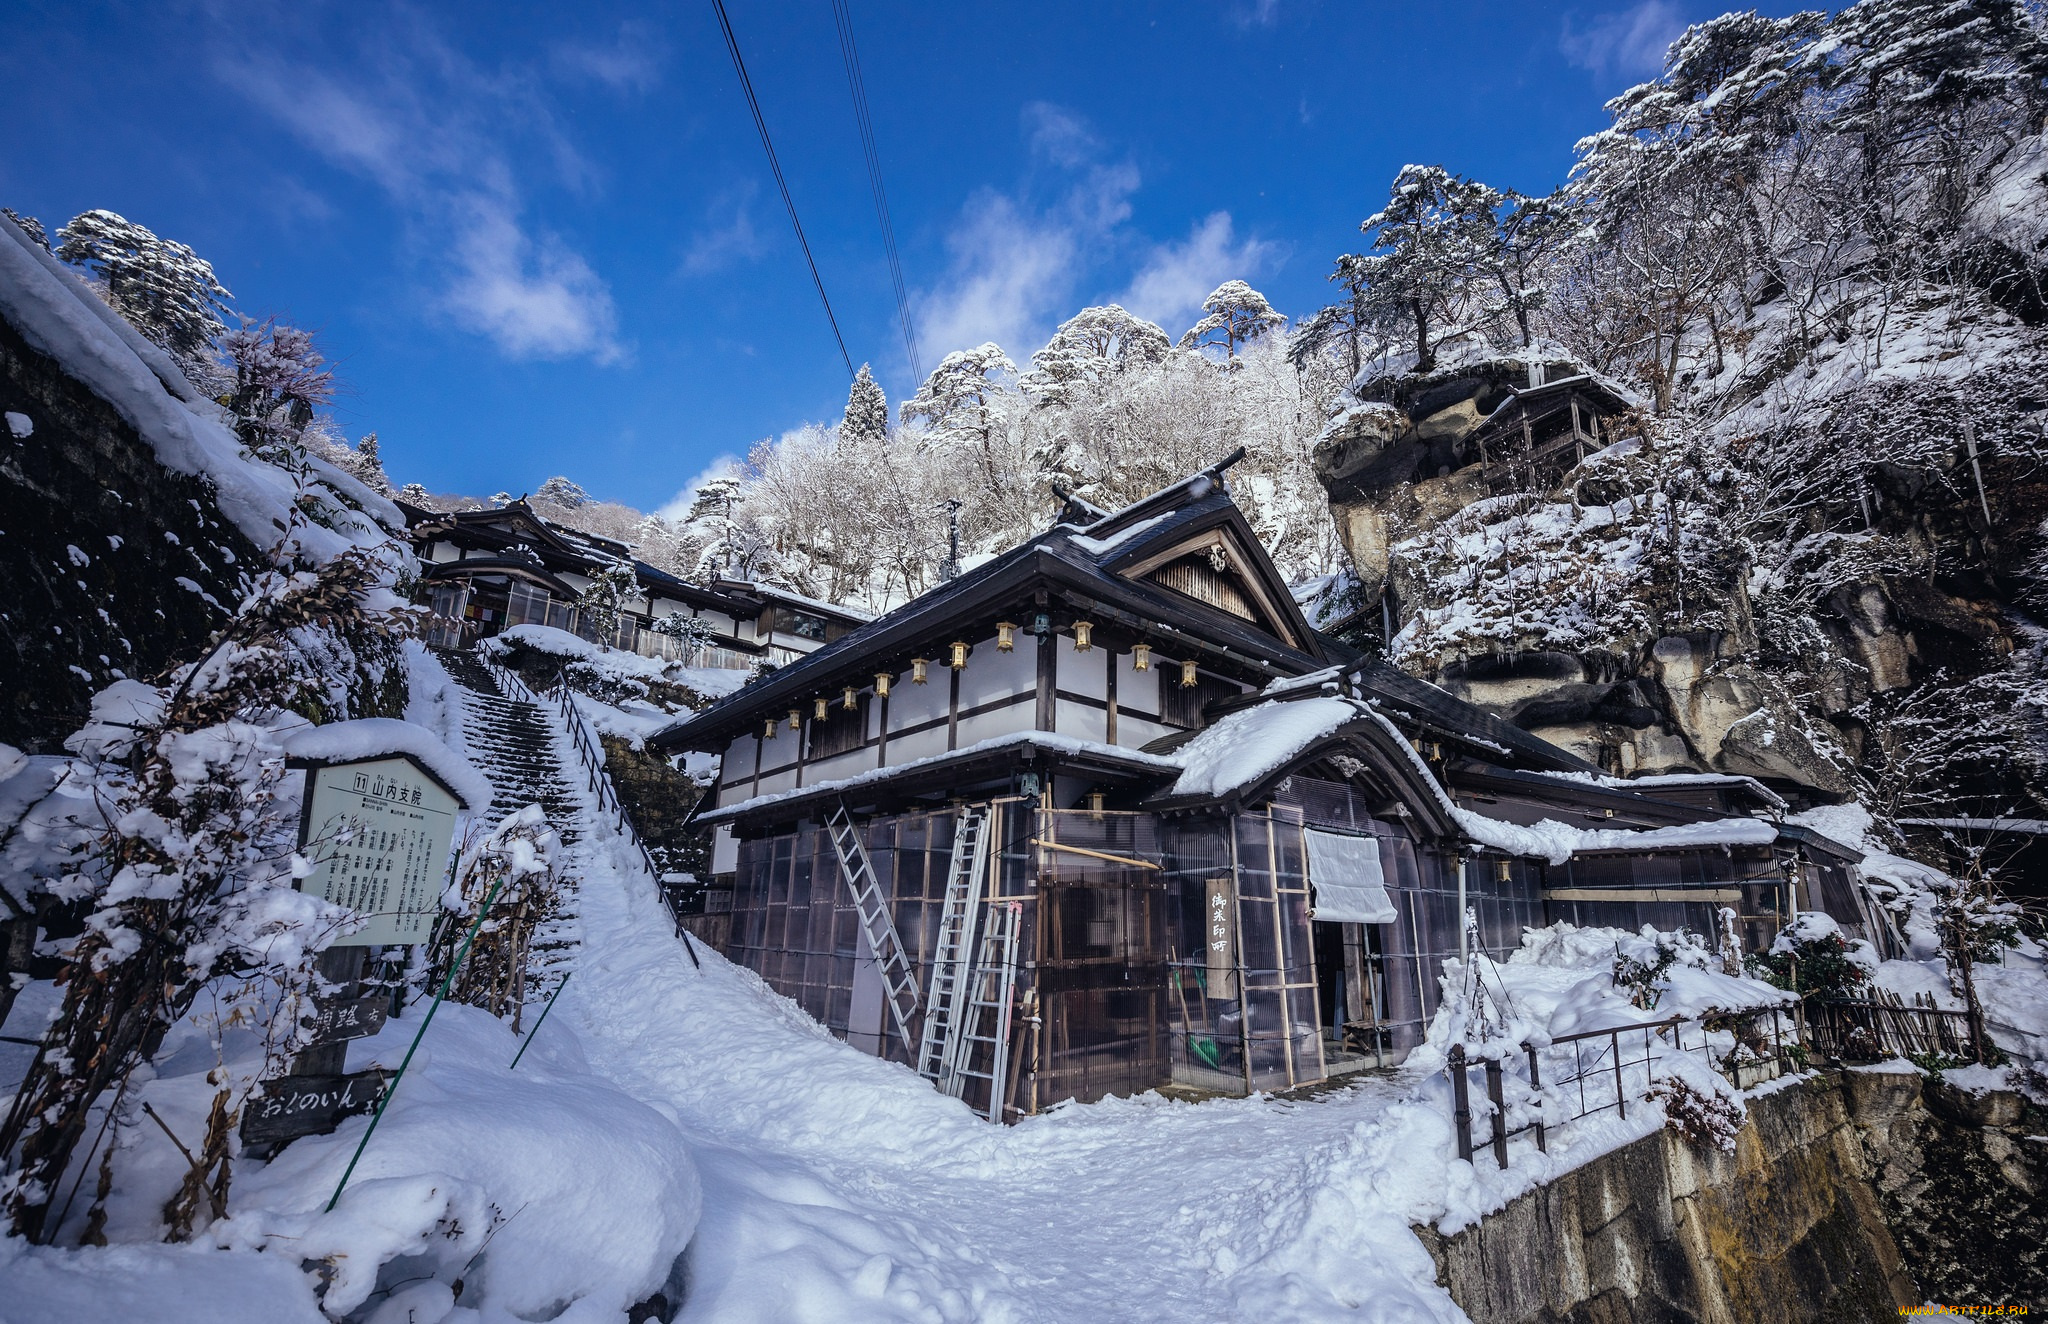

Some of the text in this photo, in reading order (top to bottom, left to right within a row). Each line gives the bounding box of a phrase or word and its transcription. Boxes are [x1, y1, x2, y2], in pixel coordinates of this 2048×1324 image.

[356, 776, 422, 805] 11 山内支院
[1211, 892, 1227, 952] 御朱印所
